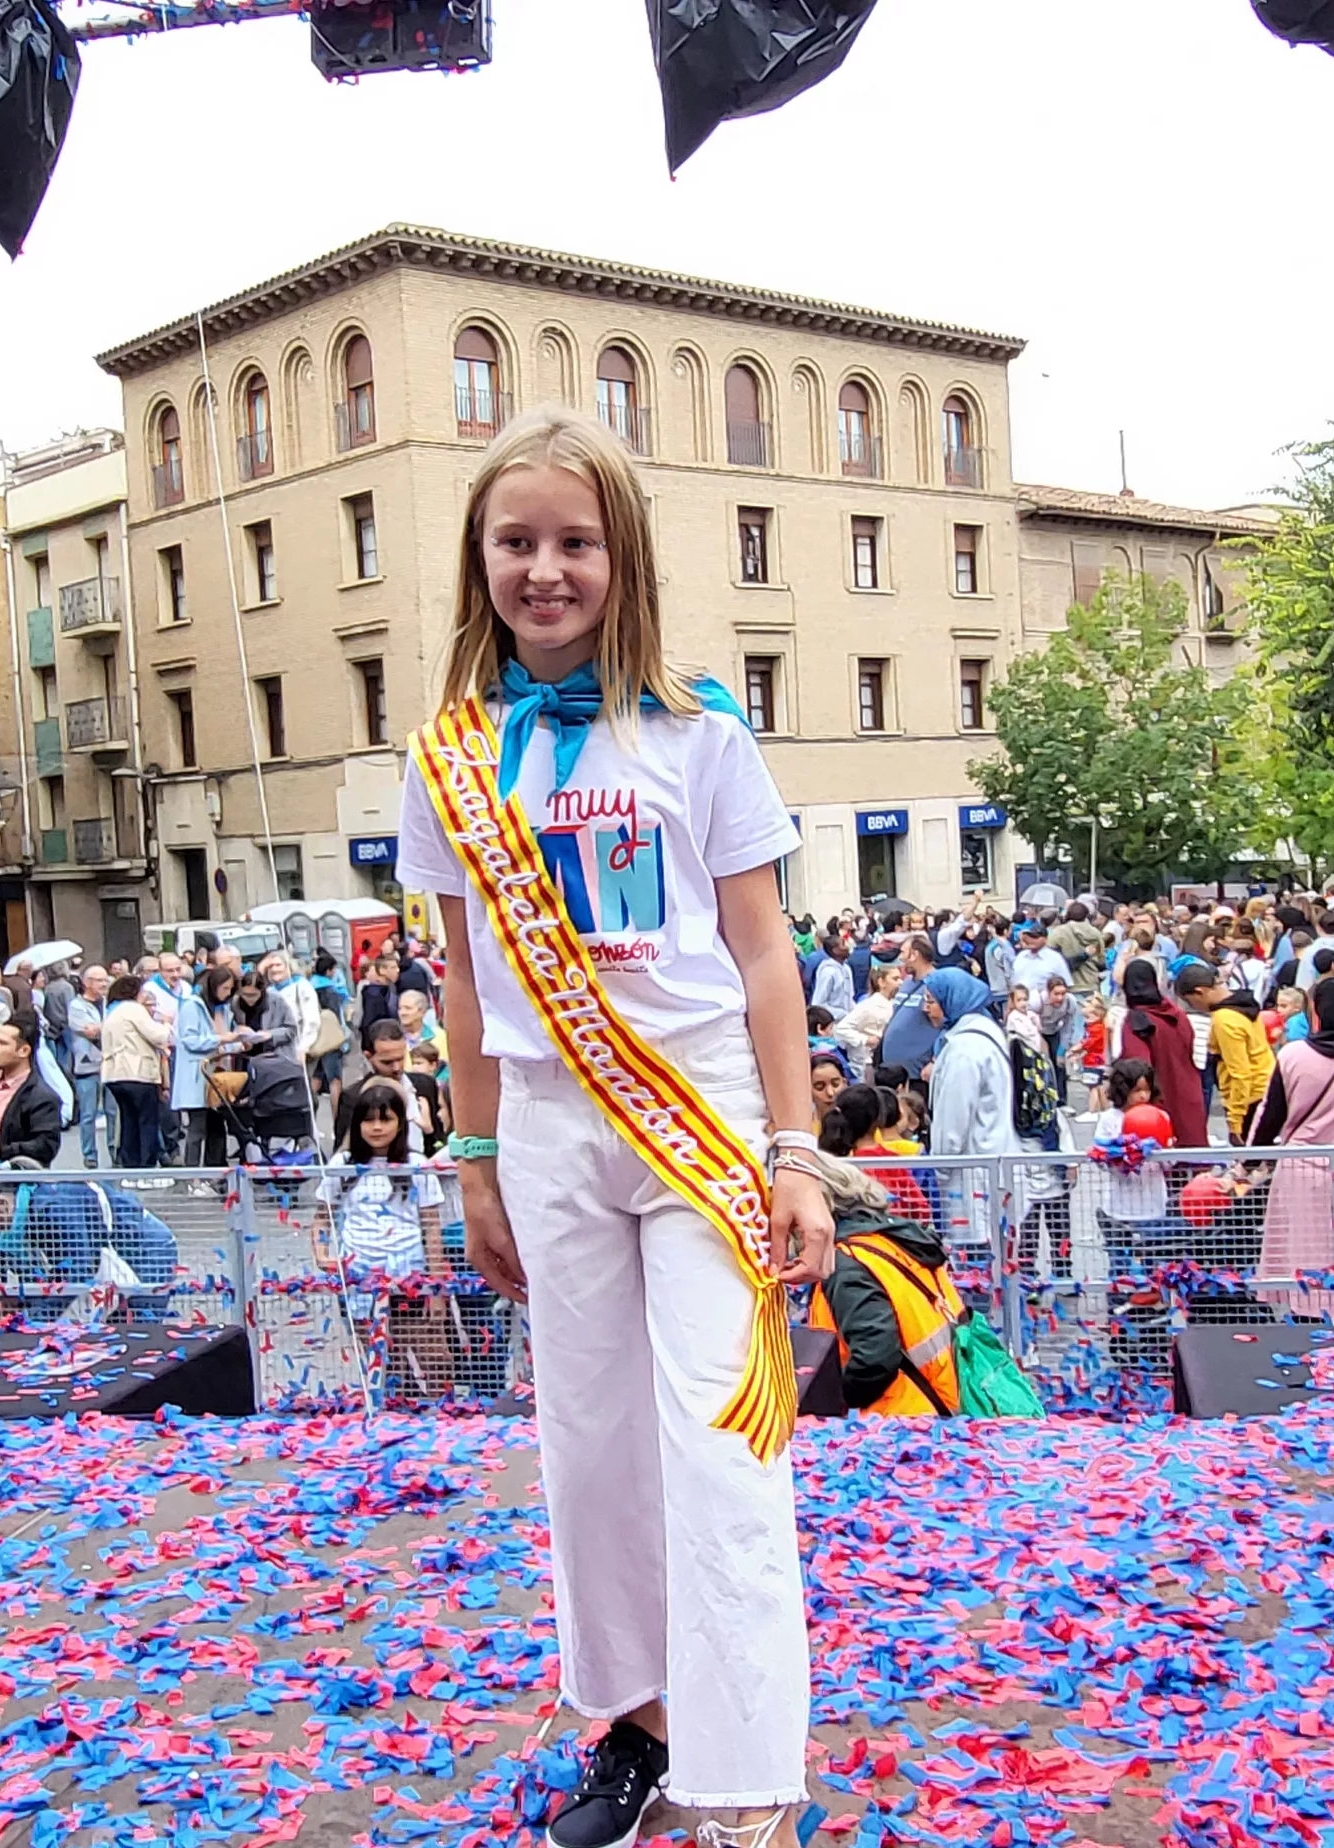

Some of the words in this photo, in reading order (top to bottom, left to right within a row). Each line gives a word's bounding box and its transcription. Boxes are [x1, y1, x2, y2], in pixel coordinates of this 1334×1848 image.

[868, 814, 899, 830] BBVA
[969, 808, 999, 823] BBVA
[545, 788, 651, 871] muy
[358, 842, 389, 860] BBVA
[532, 822, 666, 934] AN
[437, 730, 560, 980] Zagaleta
[548, 967, 699, 1166] Monzón
[587, 937, 660, 963] onzón
